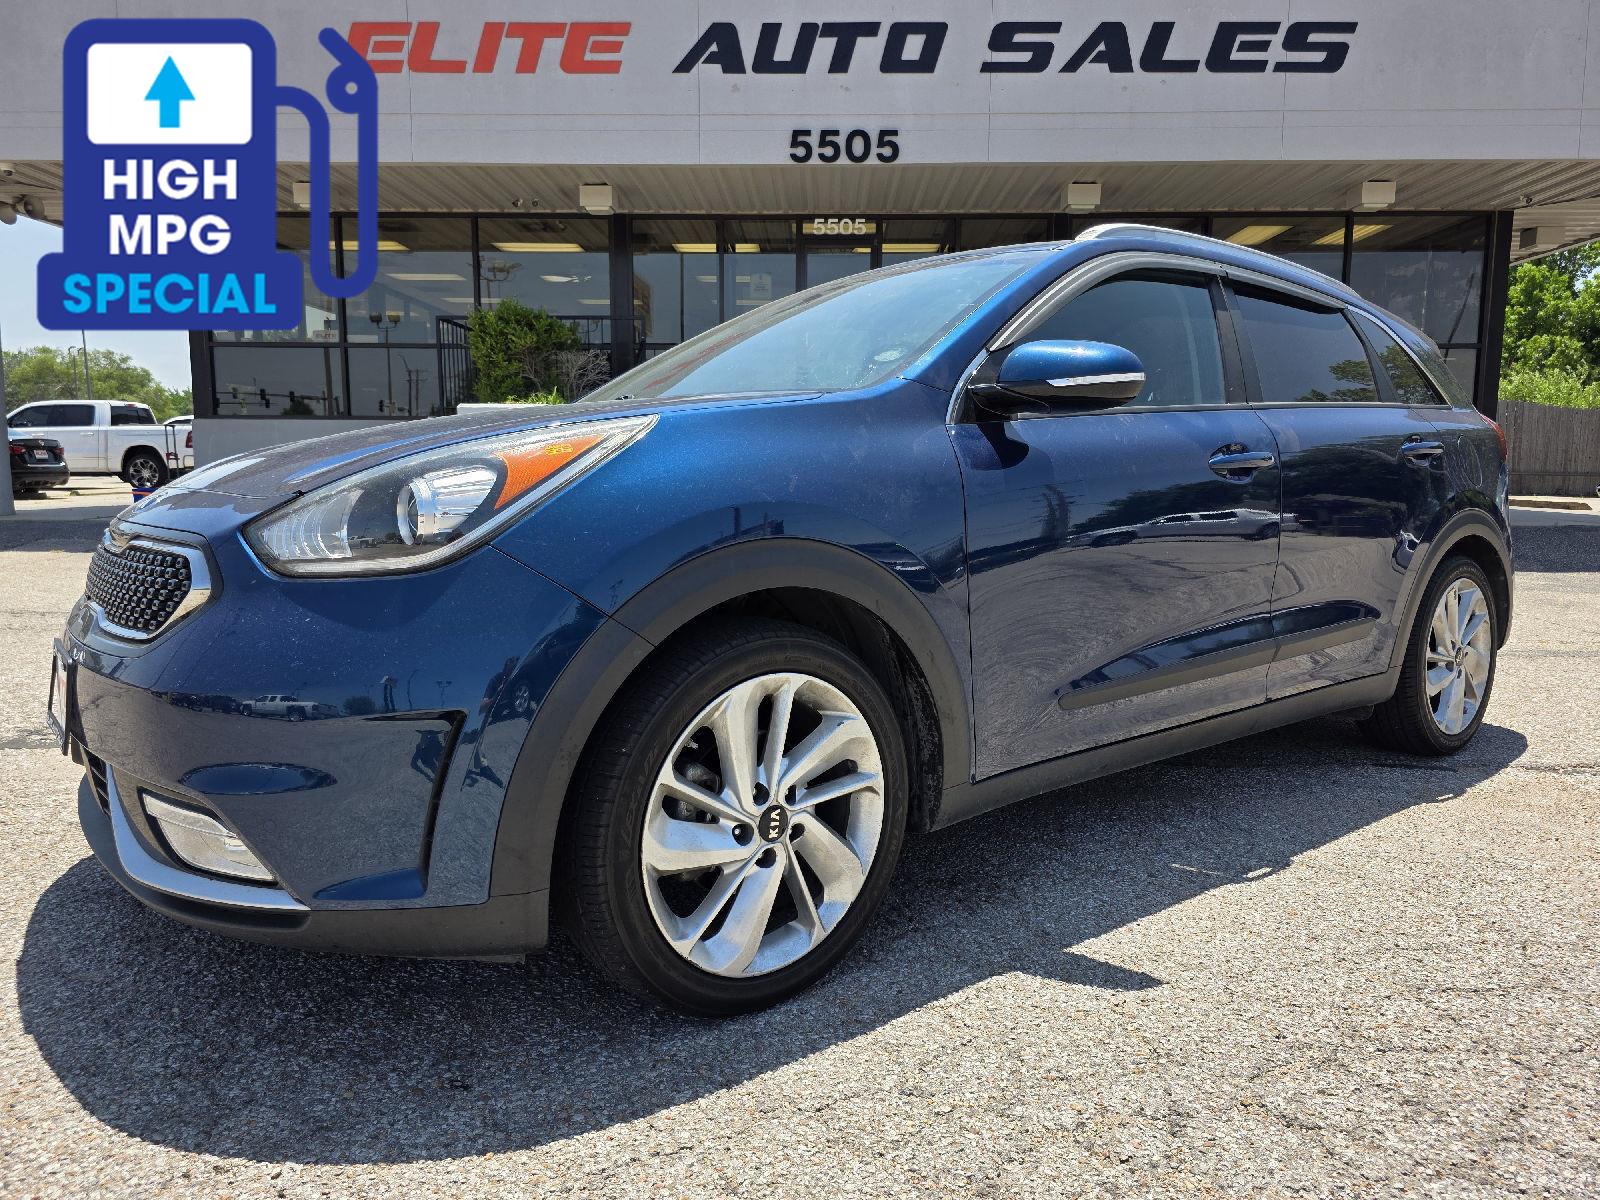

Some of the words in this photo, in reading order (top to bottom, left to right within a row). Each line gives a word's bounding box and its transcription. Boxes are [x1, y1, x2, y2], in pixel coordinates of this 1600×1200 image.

[348, 22, 630, 74] ELITE
[673, 22, 948, 74] AUTO
[981, 22, 1358, 74] SALES
[790, 129, 900, 164] 5505
[812, 218, 867, 235] 5505
[768, 808, 781, 839] KIA
